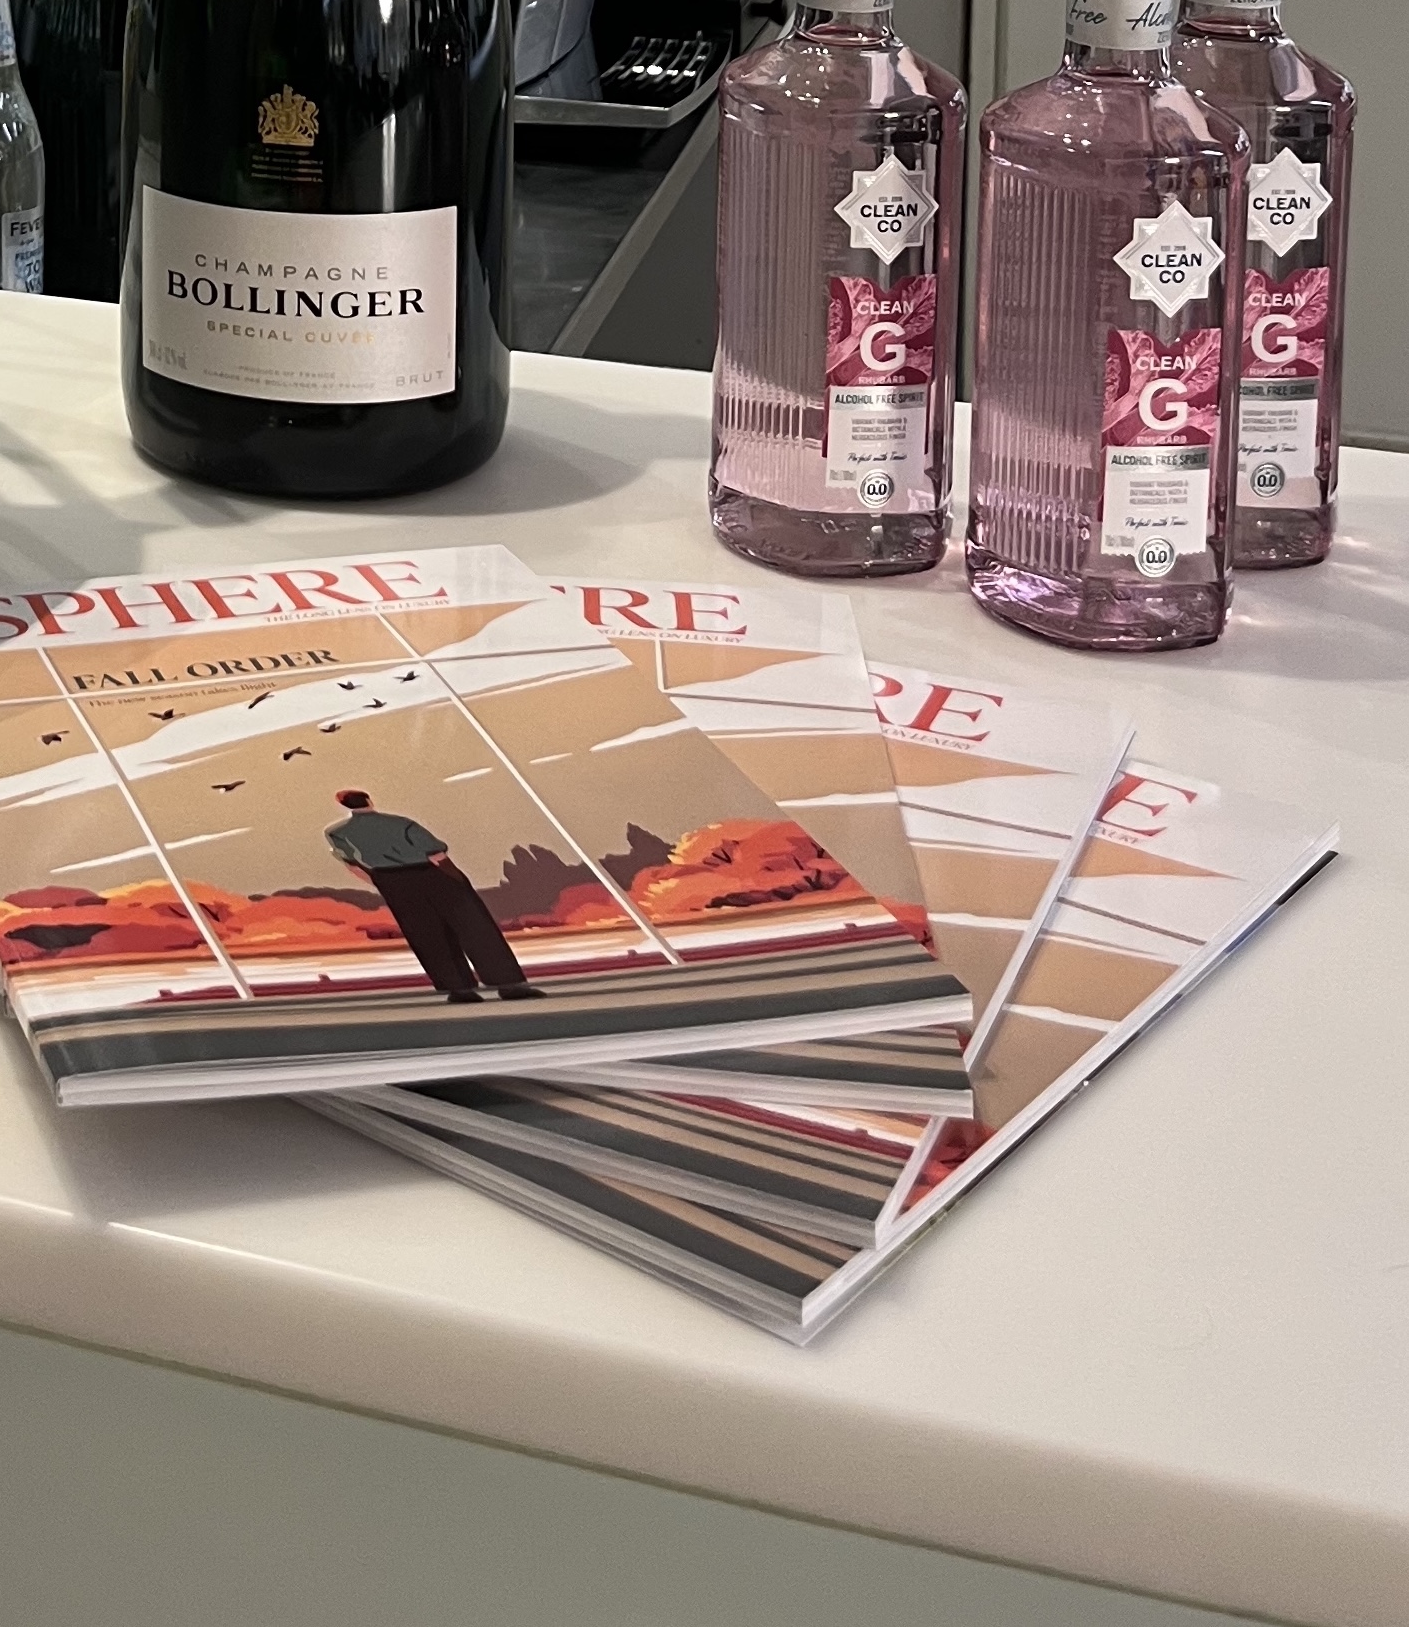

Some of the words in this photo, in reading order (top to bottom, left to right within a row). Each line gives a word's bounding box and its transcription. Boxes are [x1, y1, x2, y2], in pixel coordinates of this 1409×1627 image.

[860, 203, 918, 217] CLEAN
[1253, 197, 1310, 210] CLEAN
[1270, 212, 1294, 225] CO
[877, 220, 902, 232] CO
[1141, 253, 1202, 267] CLEAN
[195, 254, 389, 281] CHAMPAGNE
[1159, 270, 1185, 283] CO
[167, 269, 425, 319] BOLLINGER
[1249, 293, 1305, 306] CLEAN
[857, 301, 915, 315] CLEAN
[207, 320, 293, 342] SPECIAL
[1250, 314, 1298, 363] G
[859, 321, 906, 372] G
[1136, 356, 1198, 371] CLEAN
[396, 370, 443, 386] BRUT
[1267, 386, 1288, 396] FREE
[835, 394, 873, 405] ALCOHOL
[876, 394, 895, 404] FREE
[1138, 378, 1189, 431] G
[1111, 455, 1153, 465] ALCOHOL
[1155, 454, 1177, 465] FREE
[1146, 550, 1167, 563] 0.0
[550, 585, 747, 635] RE
[658, 631, 682, 639] ON
[73, 668, 178, 690] FALL
[186, 649, 340, 678] ORDER
[1095, 770, 1198, 836] E
